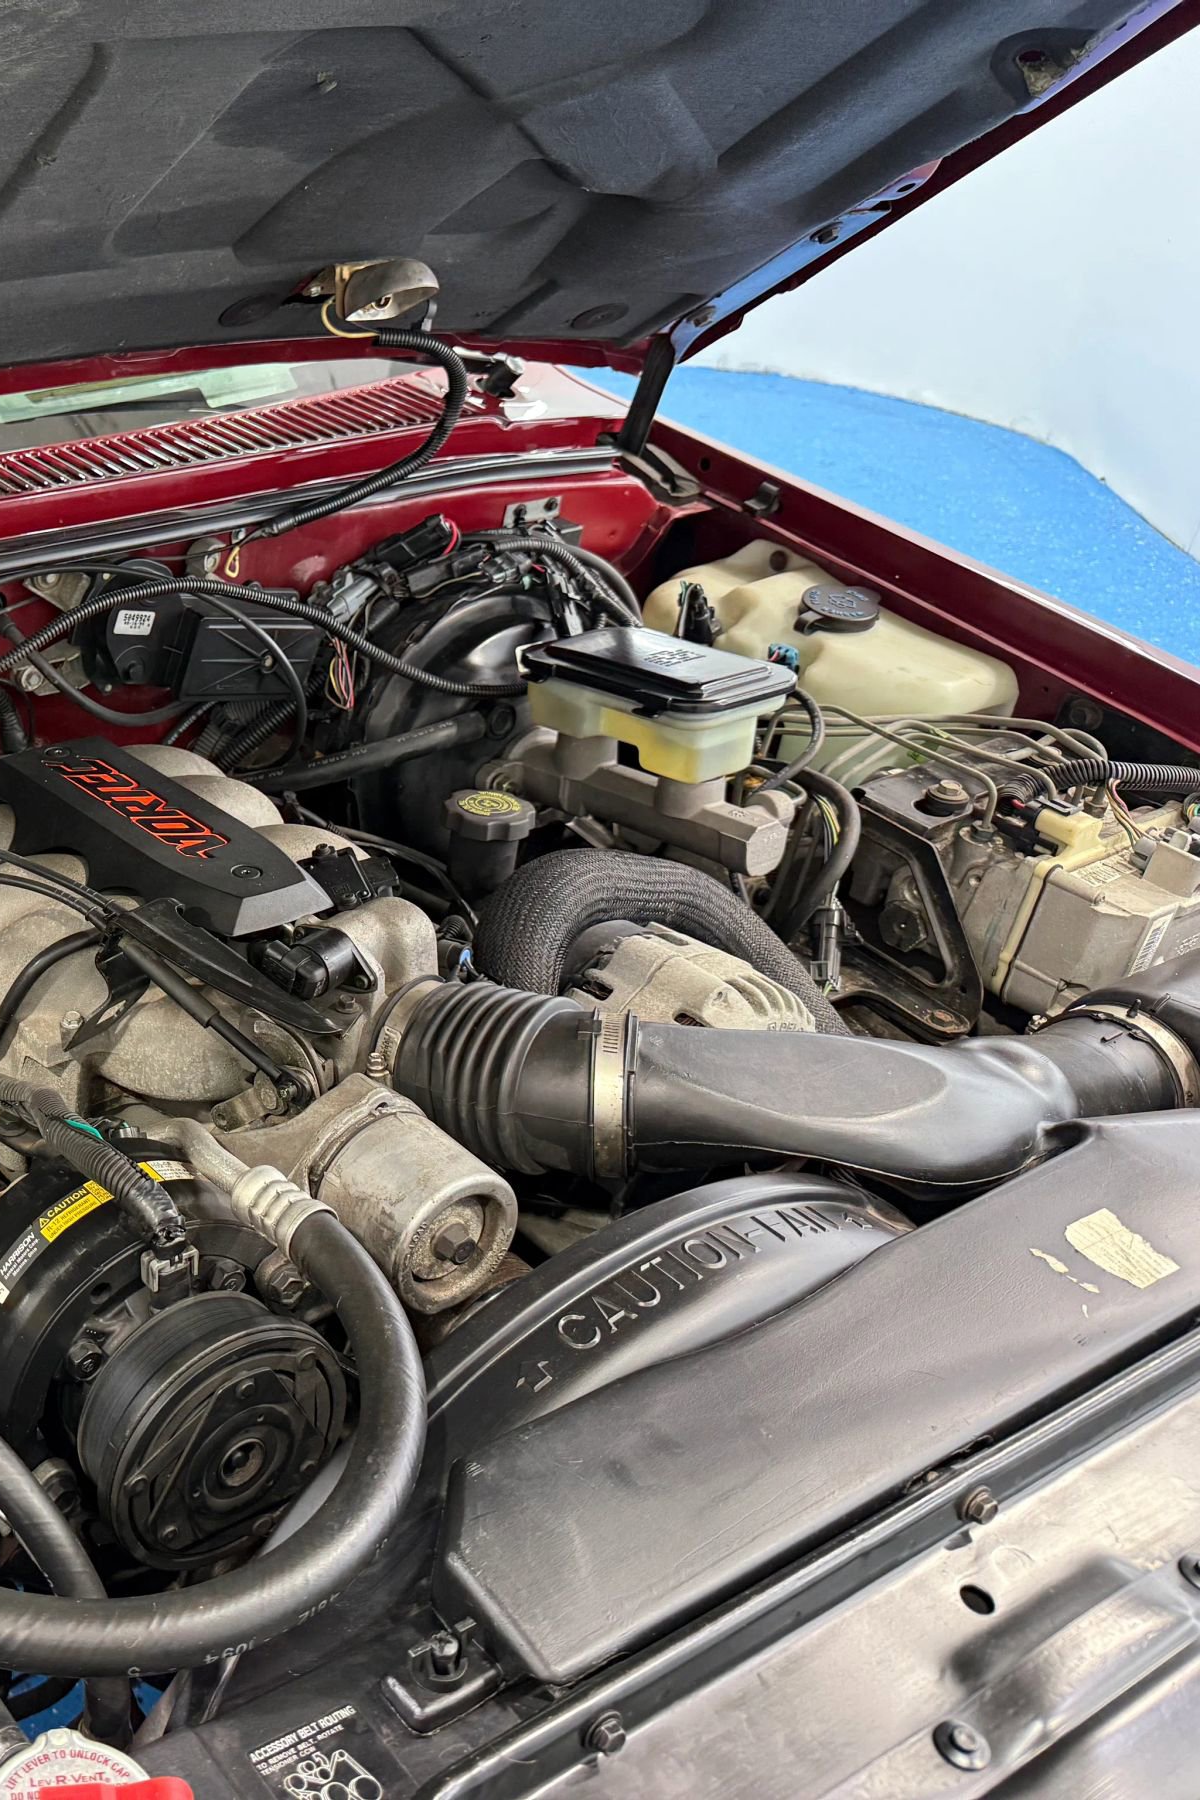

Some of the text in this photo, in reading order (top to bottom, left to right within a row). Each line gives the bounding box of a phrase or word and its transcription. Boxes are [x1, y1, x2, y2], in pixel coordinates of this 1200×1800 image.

[43, 757, 233, 859] VORTEC
[46, 1198, 91, 1233] R-12 REFRIGERANT
[47, 1188, 88, 1218] CAUTION
[49, 1224, 64, 1239] UNDER
[74, 1201, 98, 1217] PRESSURE
[0, 1231, 35, 1276] HARRISON
[557, 1205, 843, 1350] CAUTION-FAN
[250, 1704, 357, 1764] ACCESSORY BELT ROUTING
[256, 1761, 268, 1771] TO
[268, 1748, 298, 1765] REMOVE
[315, 1724, 345, 1744] ROTATE
[5, 1749, 131, 1791] LIFT LEVER TO UNLOCK CAP
[259, 1745, 318, 1776] TENSIONER CCW
[10, 1791, 25, 1800] DO
